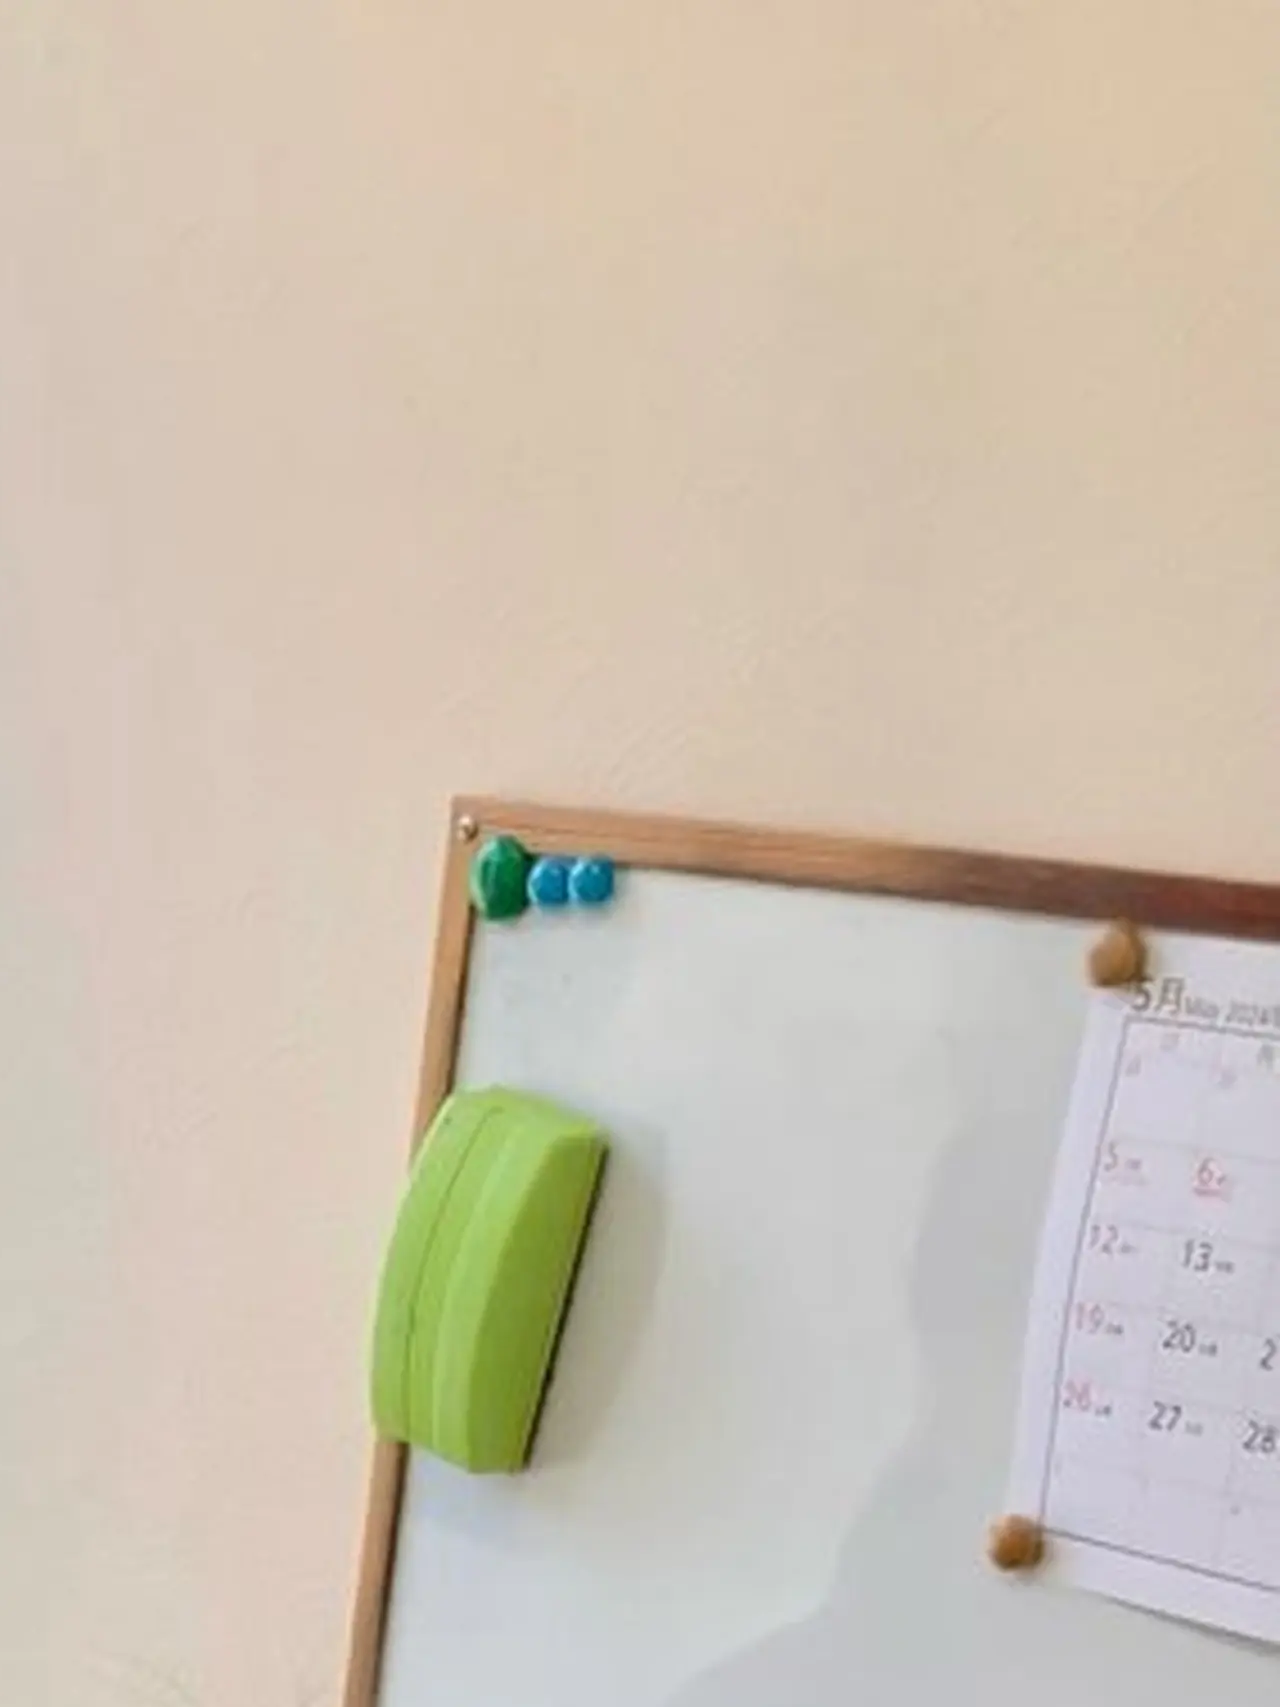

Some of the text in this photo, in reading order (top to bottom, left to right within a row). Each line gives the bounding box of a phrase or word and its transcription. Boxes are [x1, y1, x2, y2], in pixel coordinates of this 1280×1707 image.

[1089, 1224, 1214, 1273] 12 13
[1074, 1303, 1105, 1335] 19
[1161, 1320, 1197, 1354] 20
[1147, 1401, 1183, 1432] 27
[1241, 1419, 1280, 1454] 28
